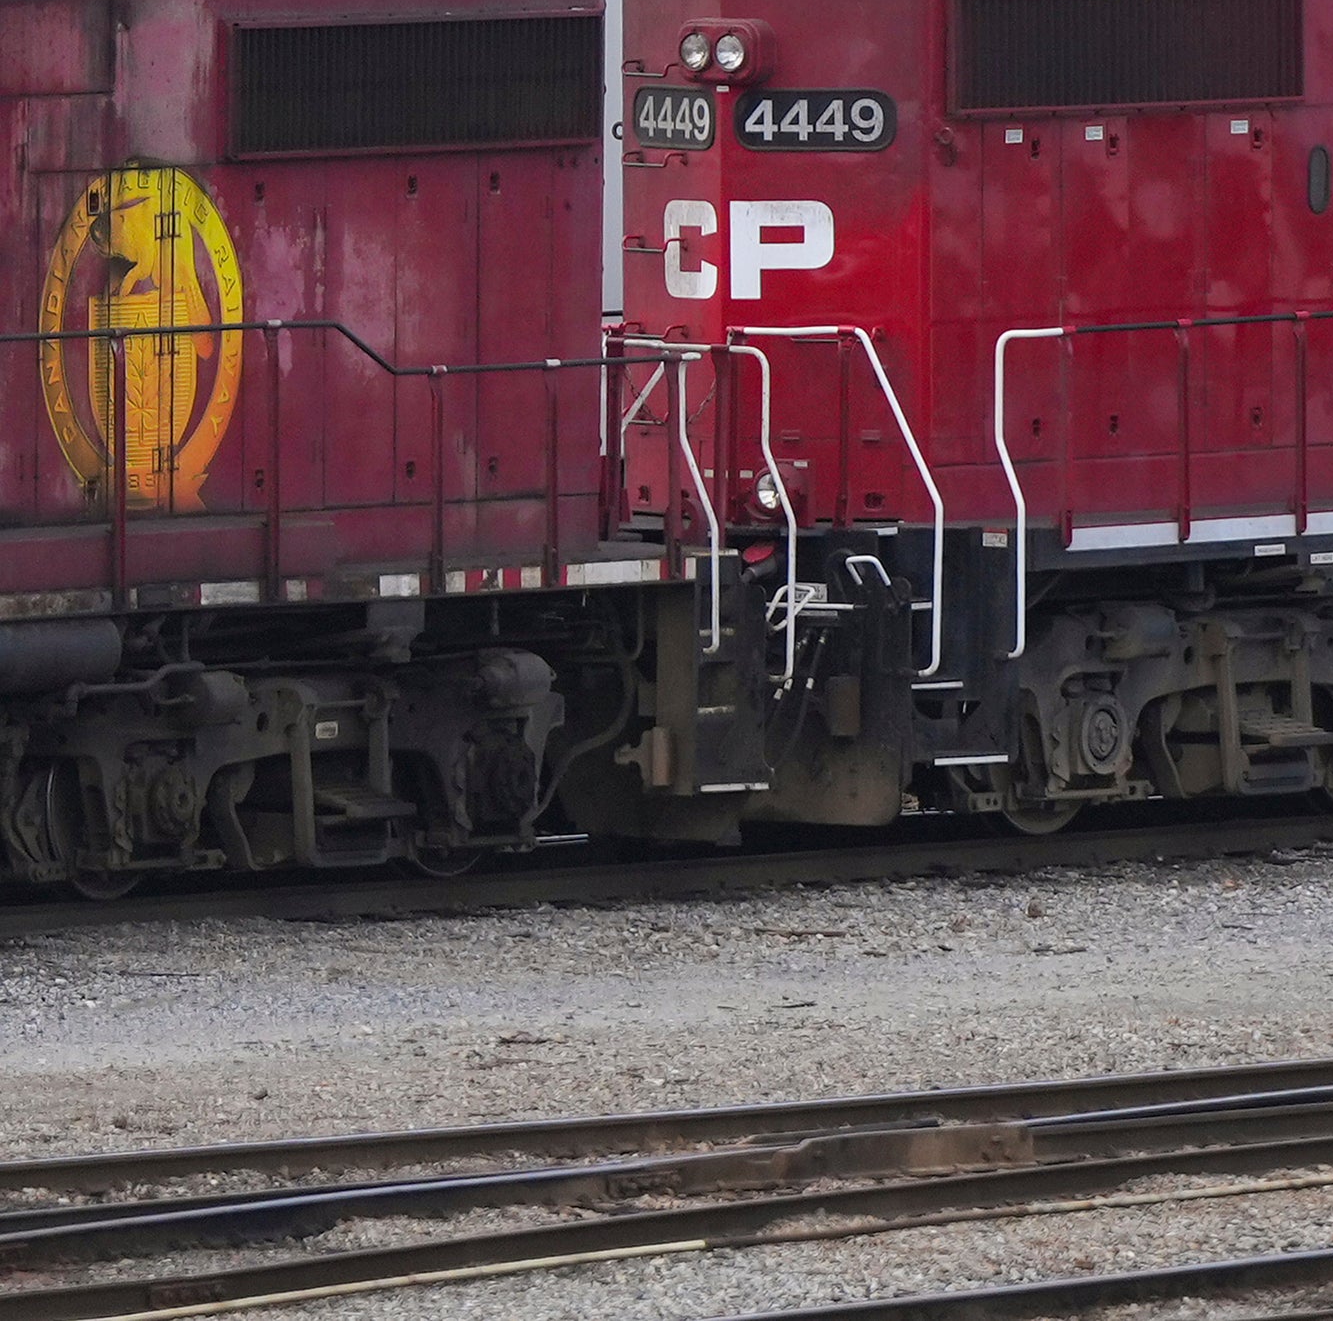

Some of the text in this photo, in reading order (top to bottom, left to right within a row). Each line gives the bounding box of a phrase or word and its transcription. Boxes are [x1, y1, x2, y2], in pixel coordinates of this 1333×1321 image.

[638, 95, 711, 142] 4449
[743, 98, 886, 143] 4449
[663, 199, 835, 300] CP
